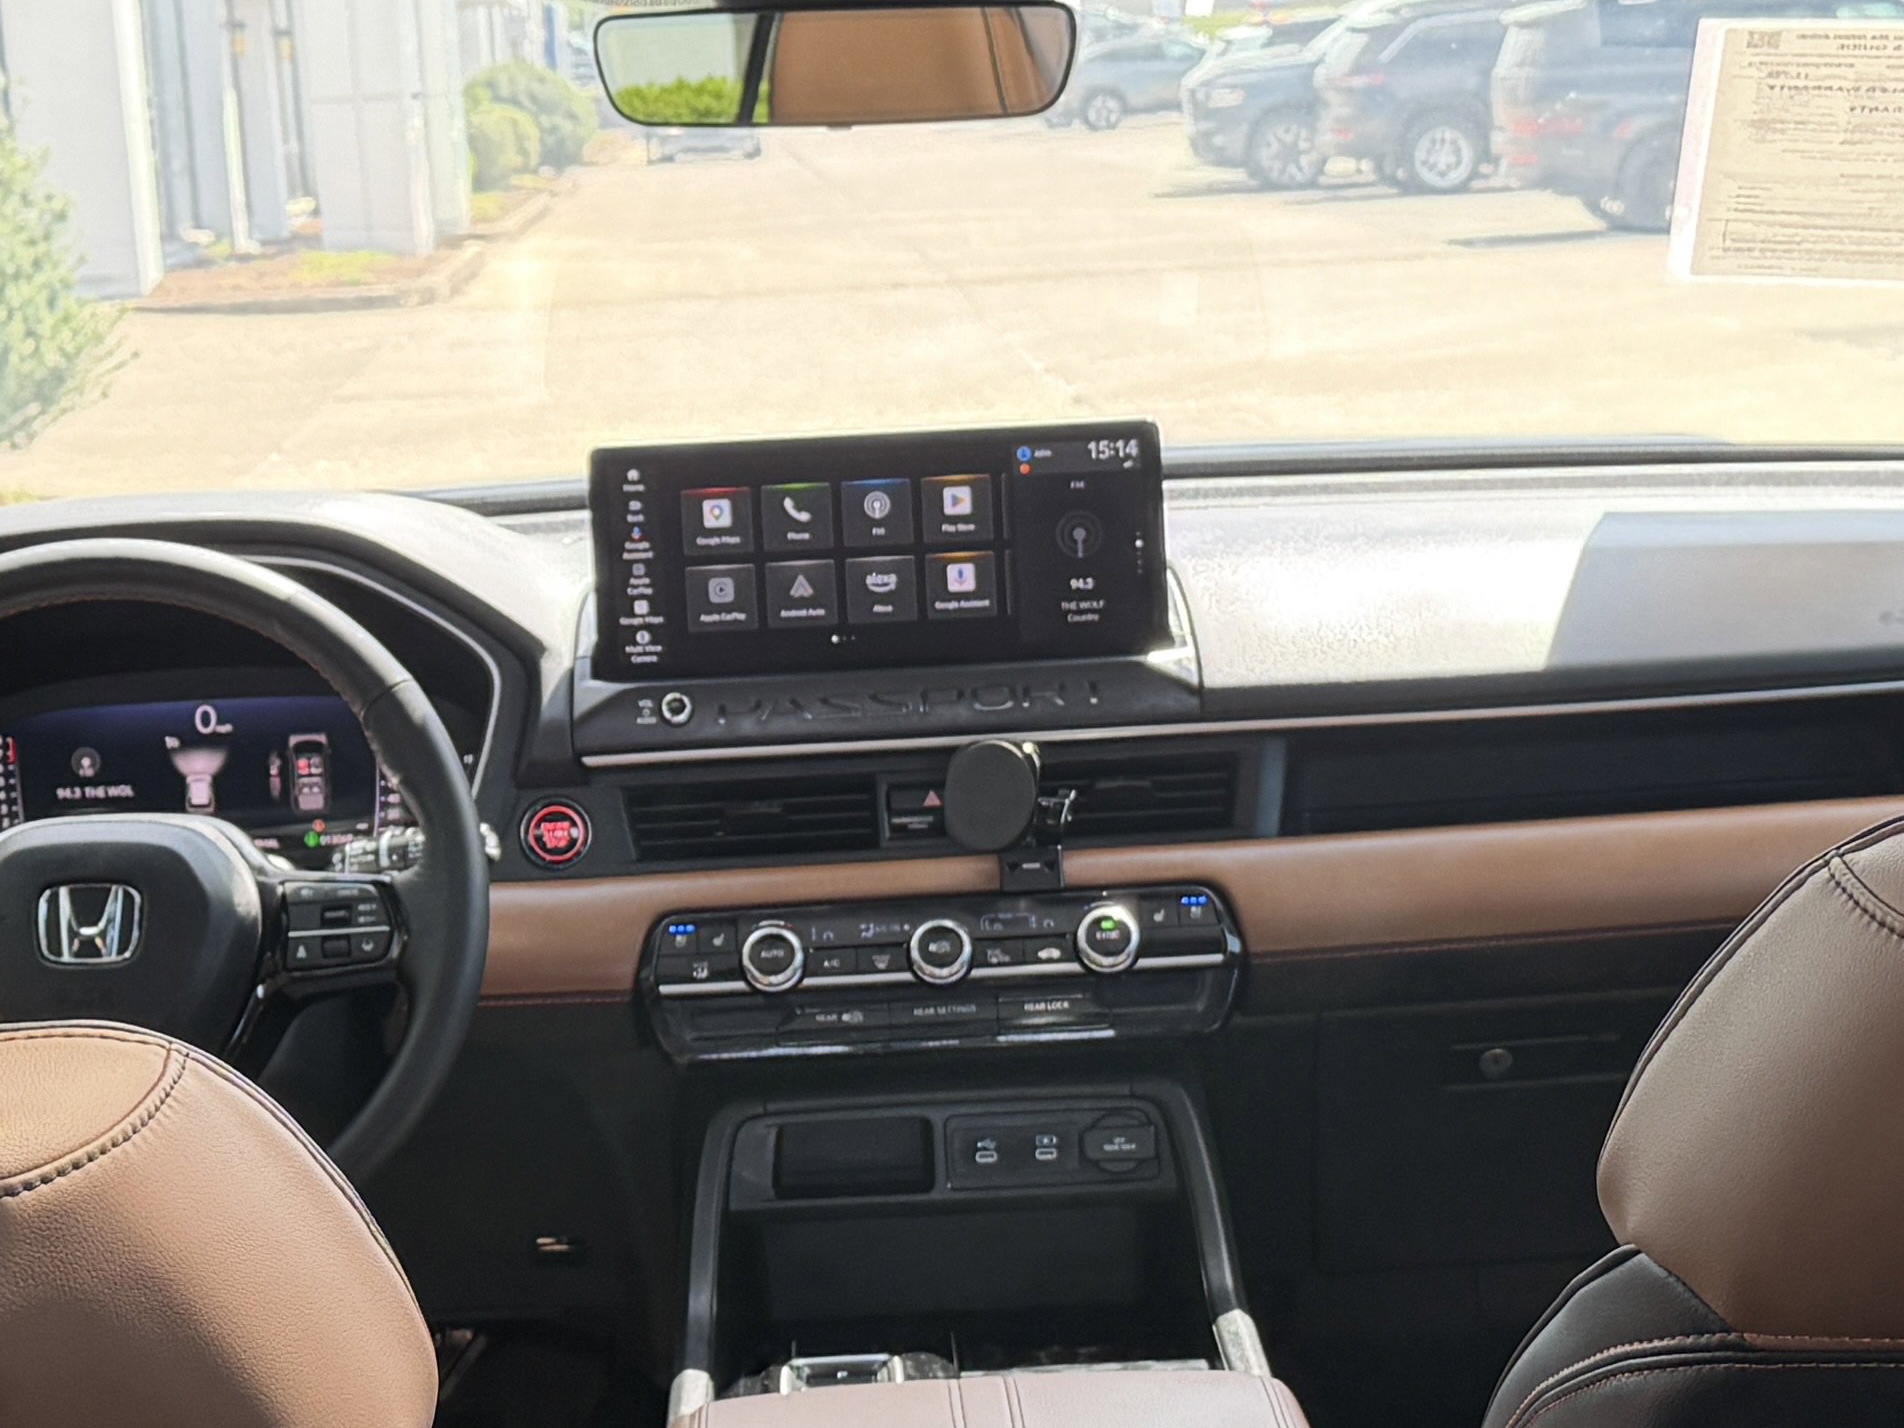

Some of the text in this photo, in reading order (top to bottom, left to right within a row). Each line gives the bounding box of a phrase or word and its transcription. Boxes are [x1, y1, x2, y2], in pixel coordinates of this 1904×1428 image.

[1088, 439, 1138, 460] 15:14
[1070, 577, 1094, 590] 94.3
[714, 680, 1102, 724] PASSPORT
[195, 704, 217, 735] 0
[760, 949, 785, 958] AUTO
[1023, 1000, 1070, 1012] REAR LOCK
